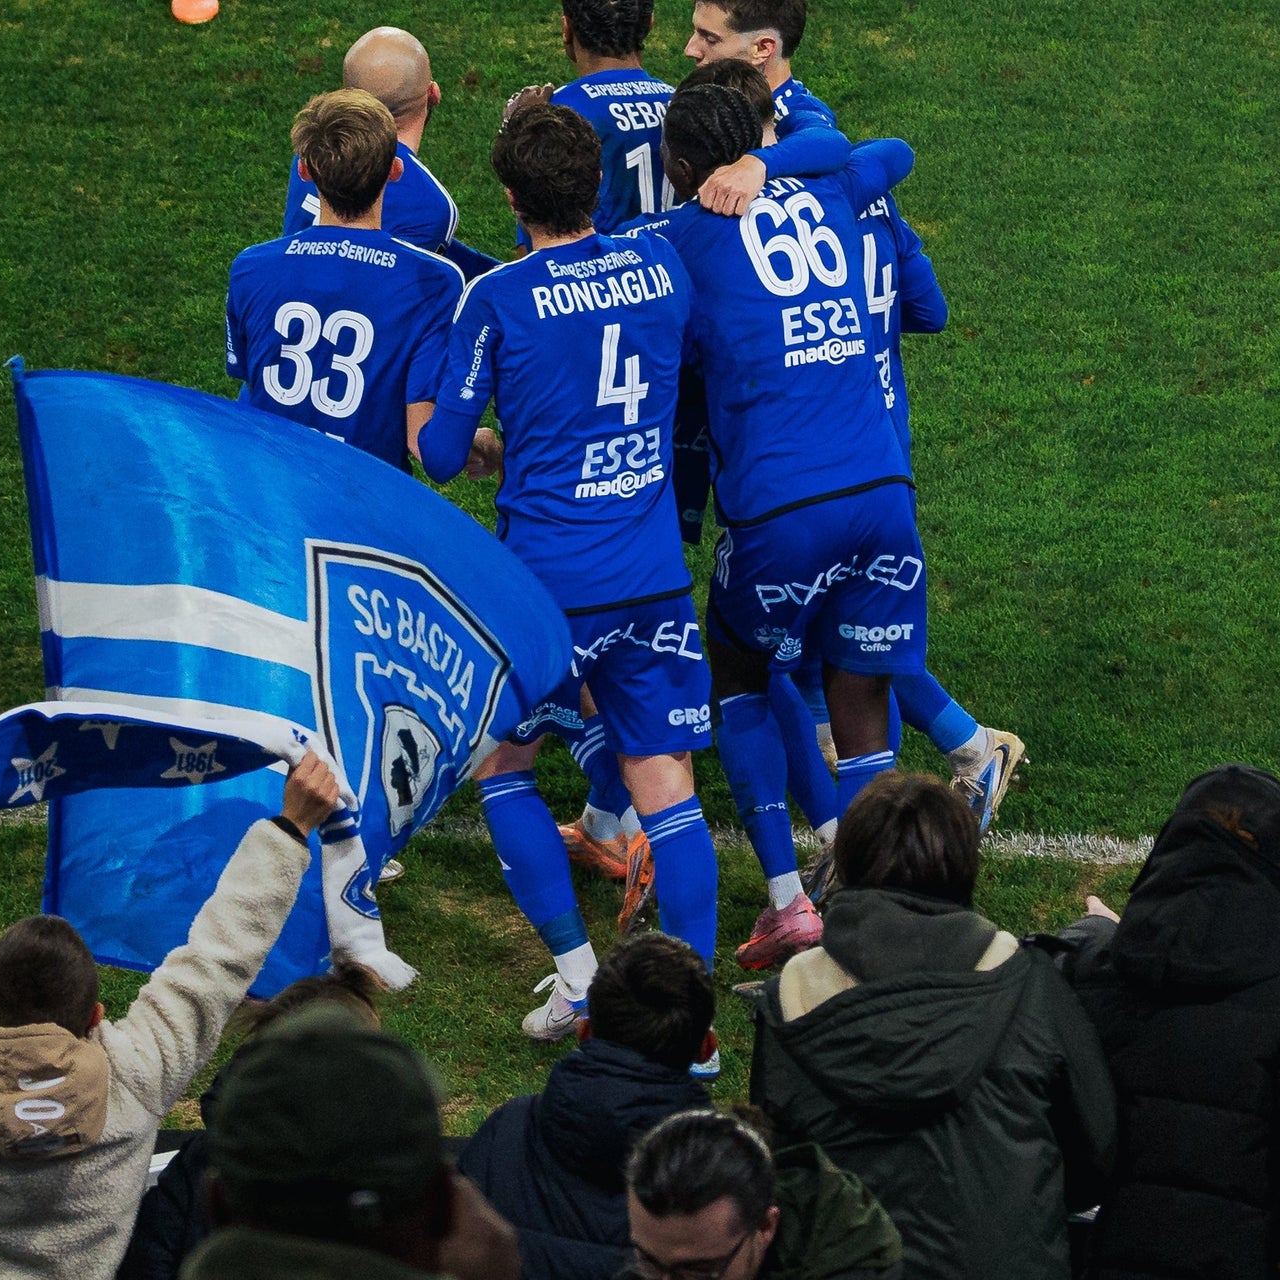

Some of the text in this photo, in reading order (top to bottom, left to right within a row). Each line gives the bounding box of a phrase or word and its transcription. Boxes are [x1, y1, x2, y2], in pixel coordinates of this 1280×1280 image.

[609, 100, 672, 132] SEBA
[739, 191, 847, 297] 66
[532, 263, 674, 320] RONCAGLIA
[263, 301, 374, 418] 33
[596, 323, 649, 426] 4
[347, 584, 392, 640] SC
[838, 624, 914, 642] GROOT
[860, 642, 892, 652] Coffee
[177, 752, 216, 773] 1981
